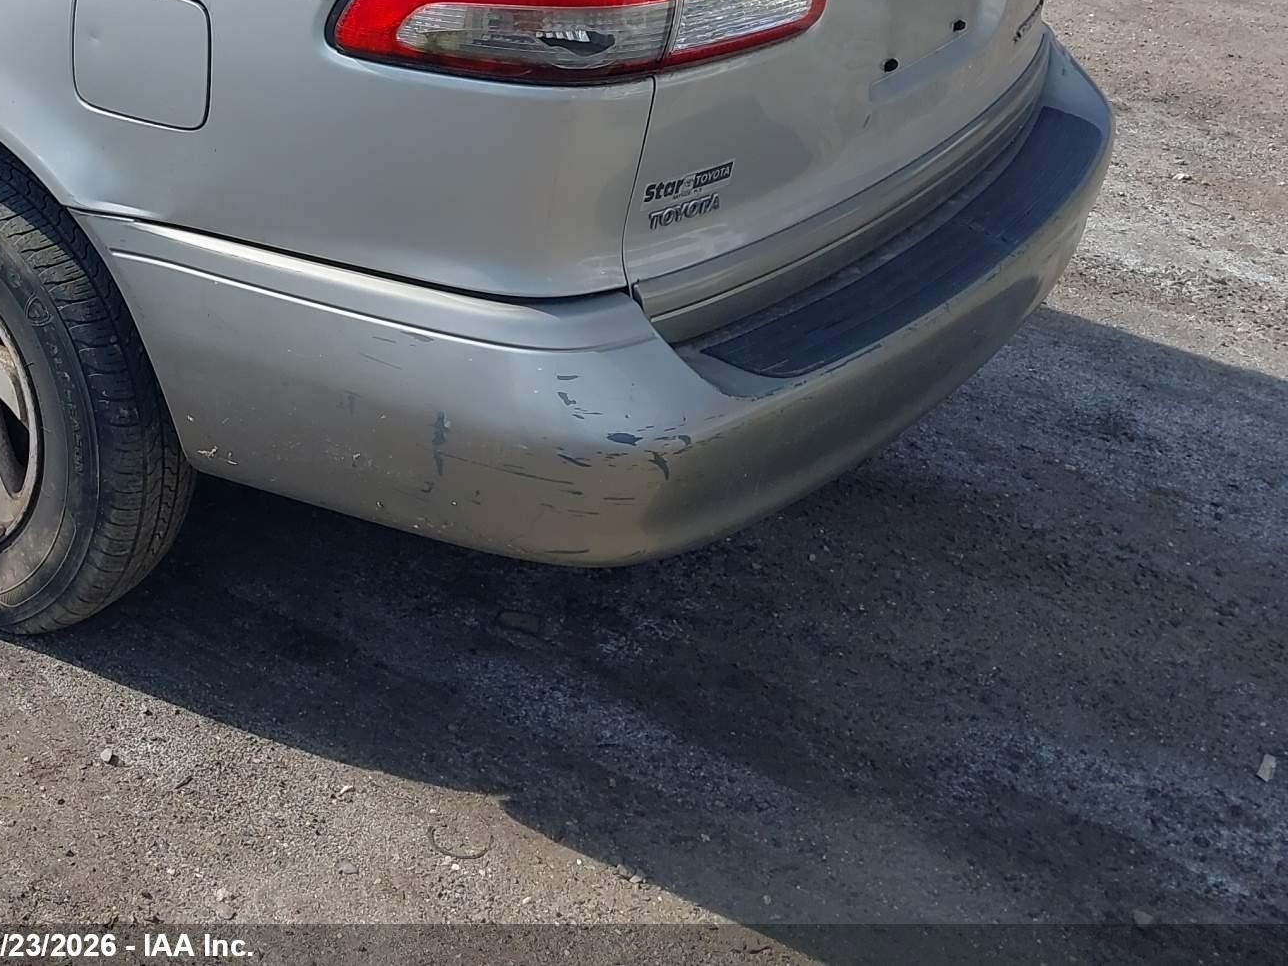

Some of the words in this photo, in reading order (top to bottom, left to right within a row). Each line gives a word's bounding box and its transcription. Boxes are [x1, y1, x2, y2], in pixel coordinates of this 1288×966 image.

[643, 177, 684, 203] Star
[695, 165, 732, 186] TOYOTA
[648, 194, 720, 229] TOYOTA
